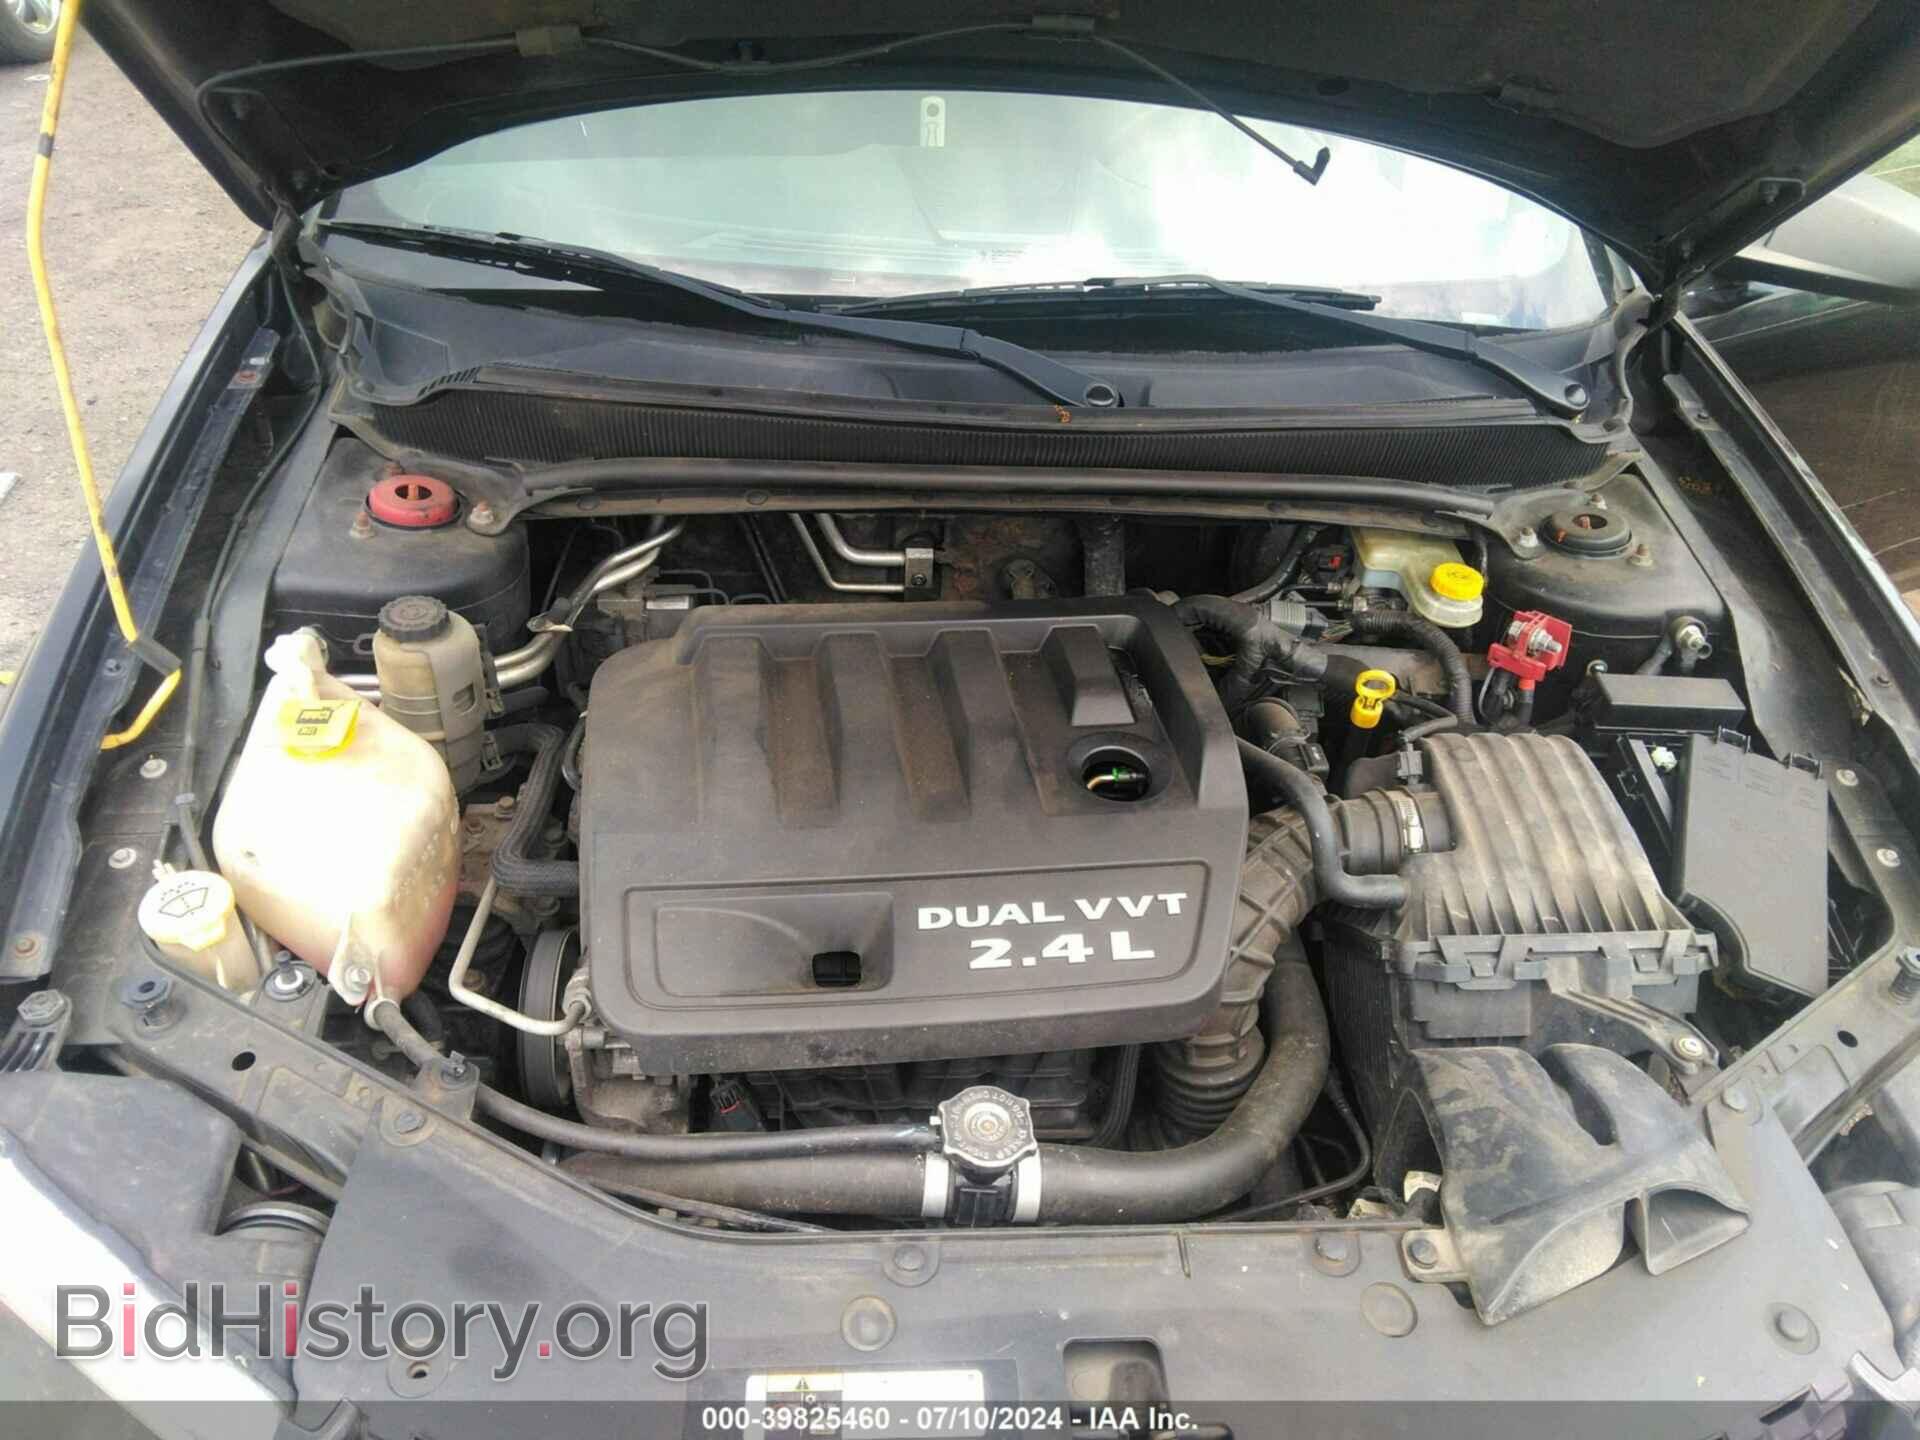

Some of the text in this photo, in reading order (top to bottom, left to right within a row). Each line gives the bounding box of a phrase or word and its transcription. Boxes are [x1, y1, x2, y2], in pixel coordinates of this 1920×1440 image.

[918, 893, 1187, 930] DUAL VVT
[969, 931, 1155, 969] 2.4 L
